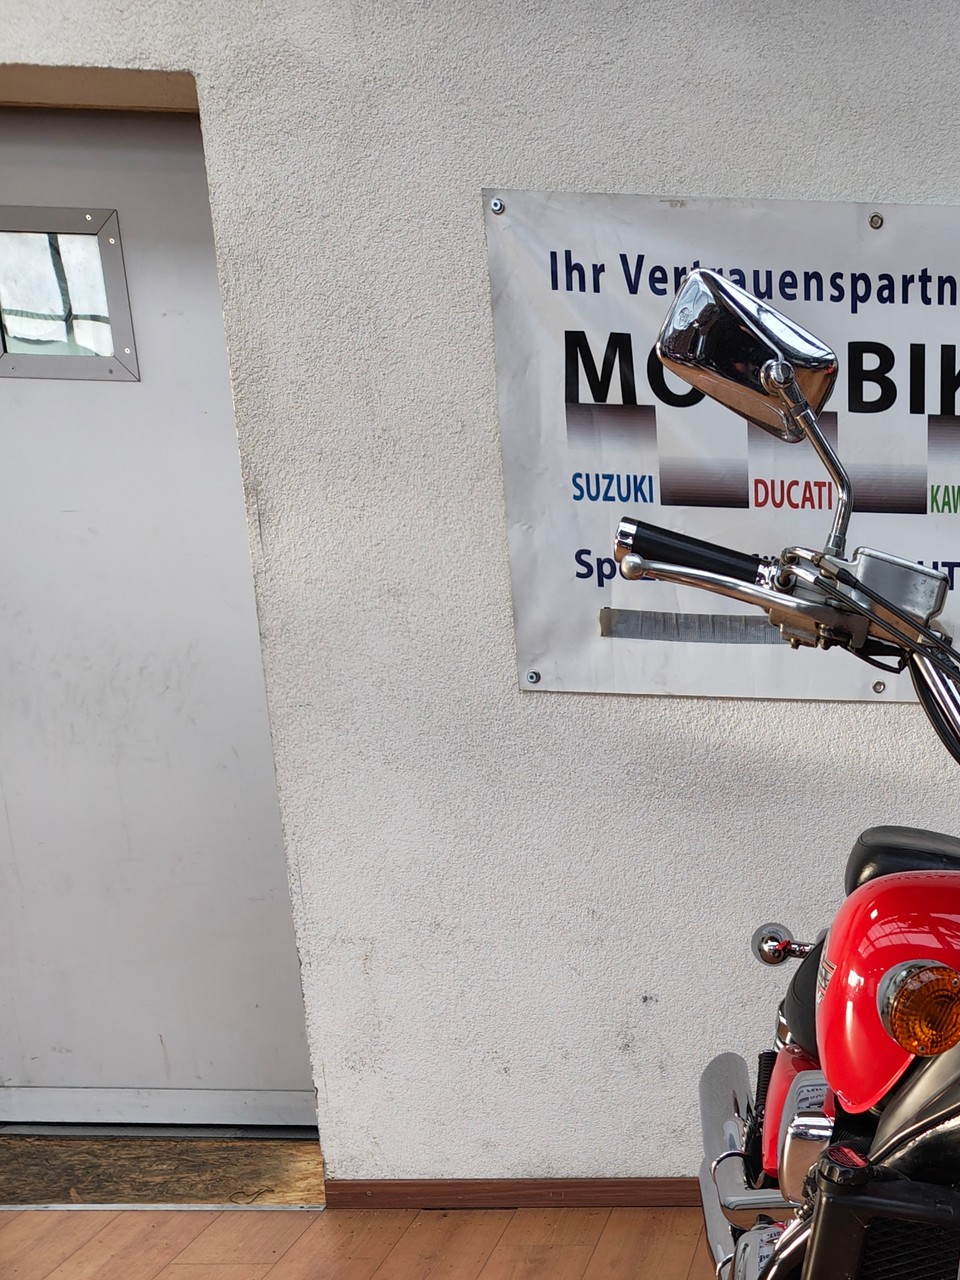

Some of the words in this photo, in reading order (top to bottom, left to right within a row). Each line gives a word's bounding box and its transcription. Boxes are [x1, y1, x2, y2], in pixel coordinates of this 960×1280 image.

[549, 249, 606, 294] Ihr
[571, 472, 654, 504] SUZUKI
[753, 479, 833, 511] DUCATI
